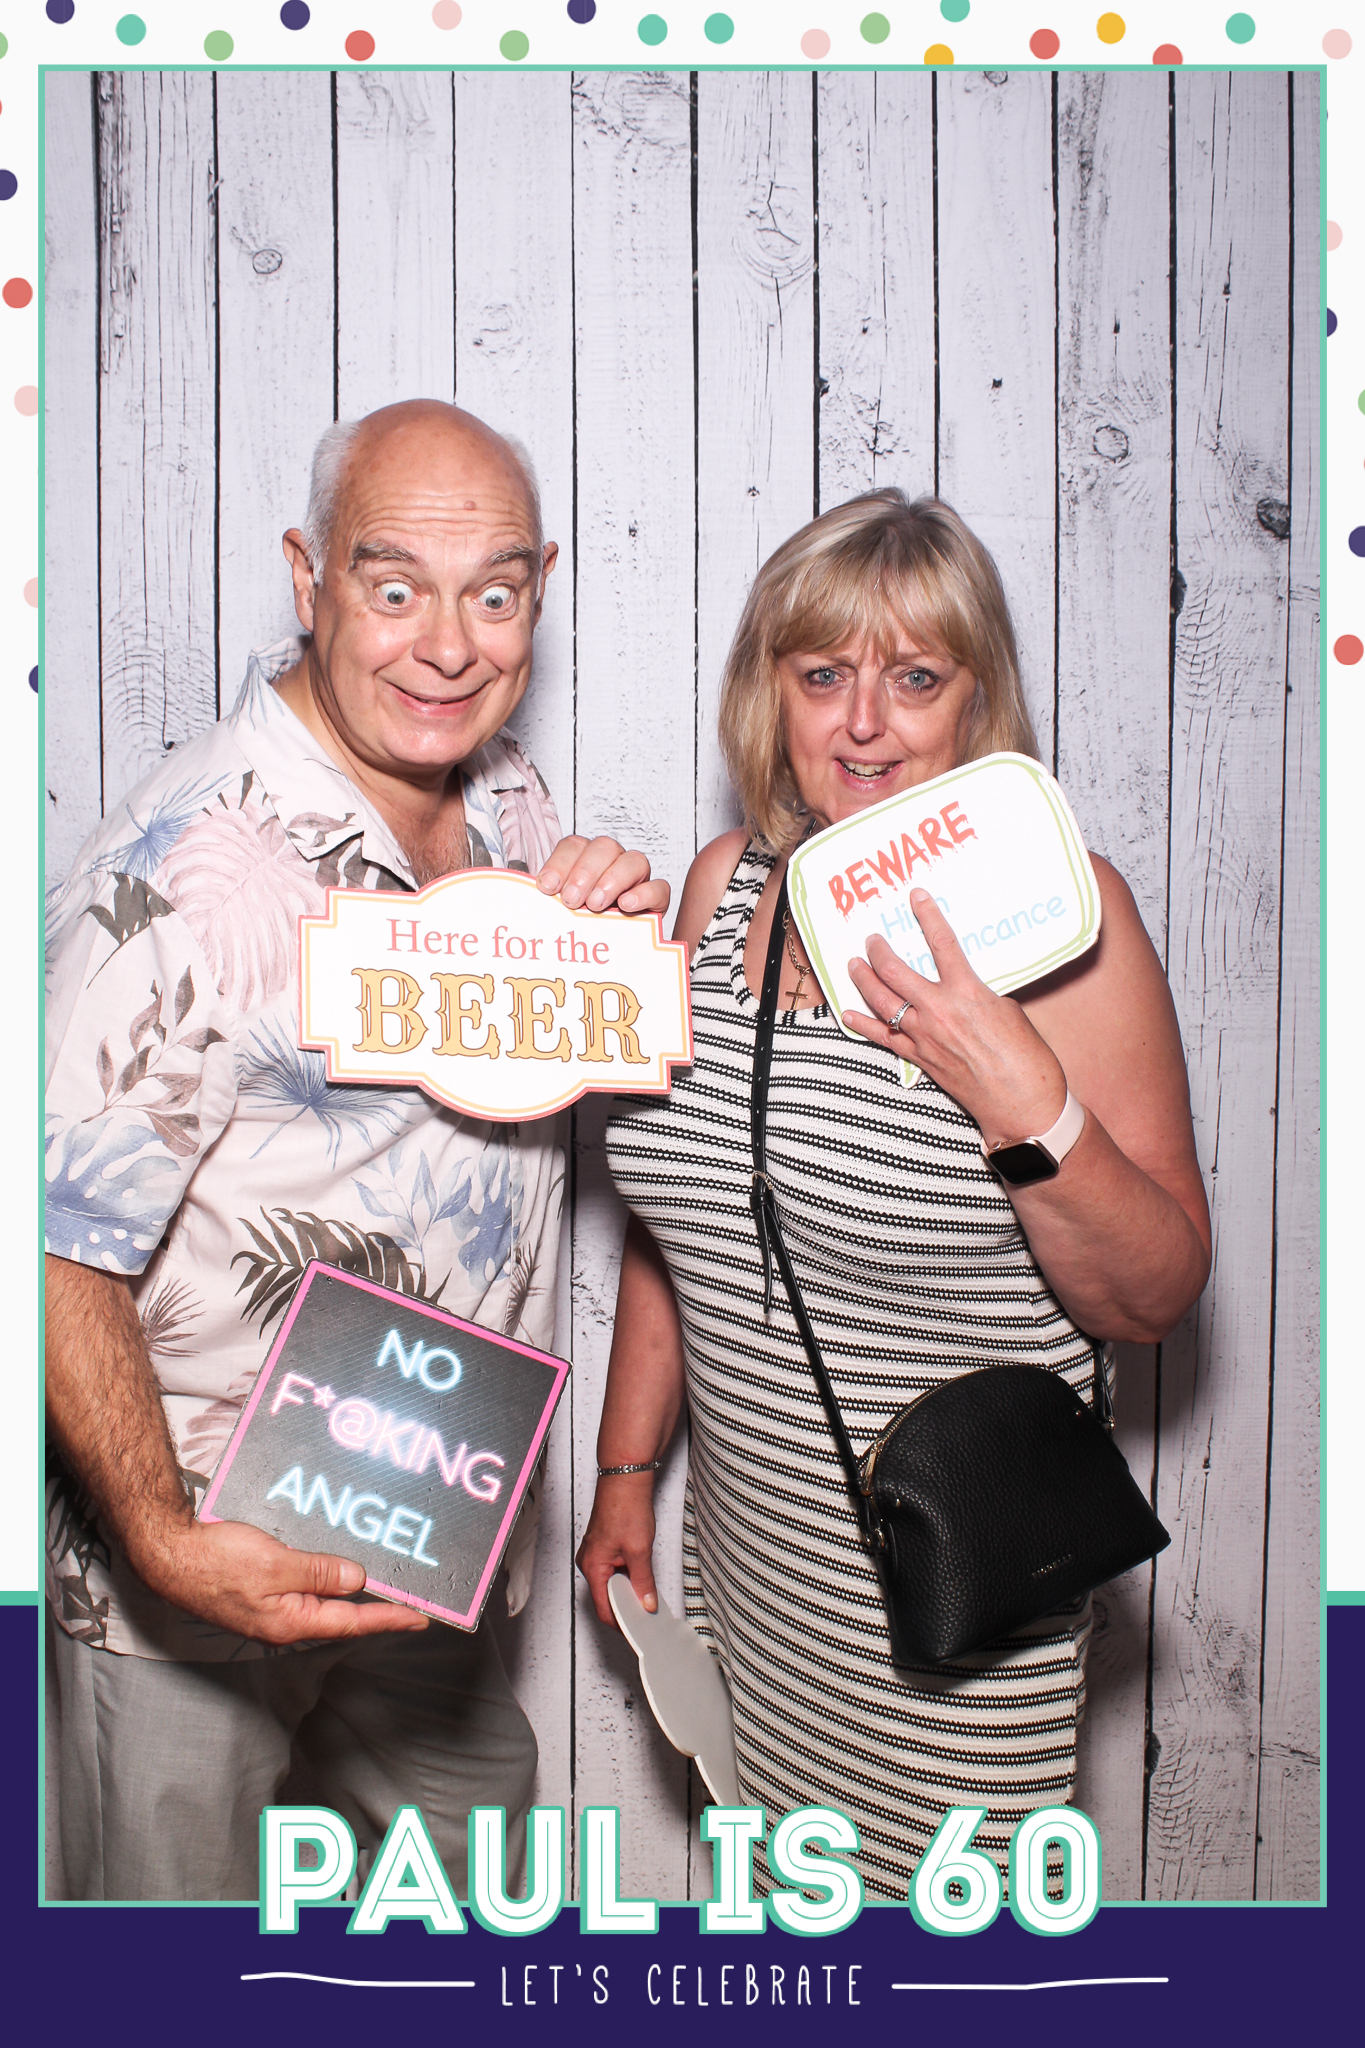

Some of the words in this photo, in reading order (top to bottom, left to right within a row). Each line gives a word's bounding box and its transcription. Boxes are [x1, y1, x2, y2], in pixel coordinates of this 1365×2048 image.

[828, 801, 978, 921] BEWARE
[387, 918, 479, 957] Here
[491, 925, 544, 961] for
[554, 930, 611, 965] the
[880, 895, 951, 940] Hi
[351, 968, 651, 1065] BEER
[376, 1328, 462, 1391] NO
[266, 1466, 439, 1567] ANGEL
